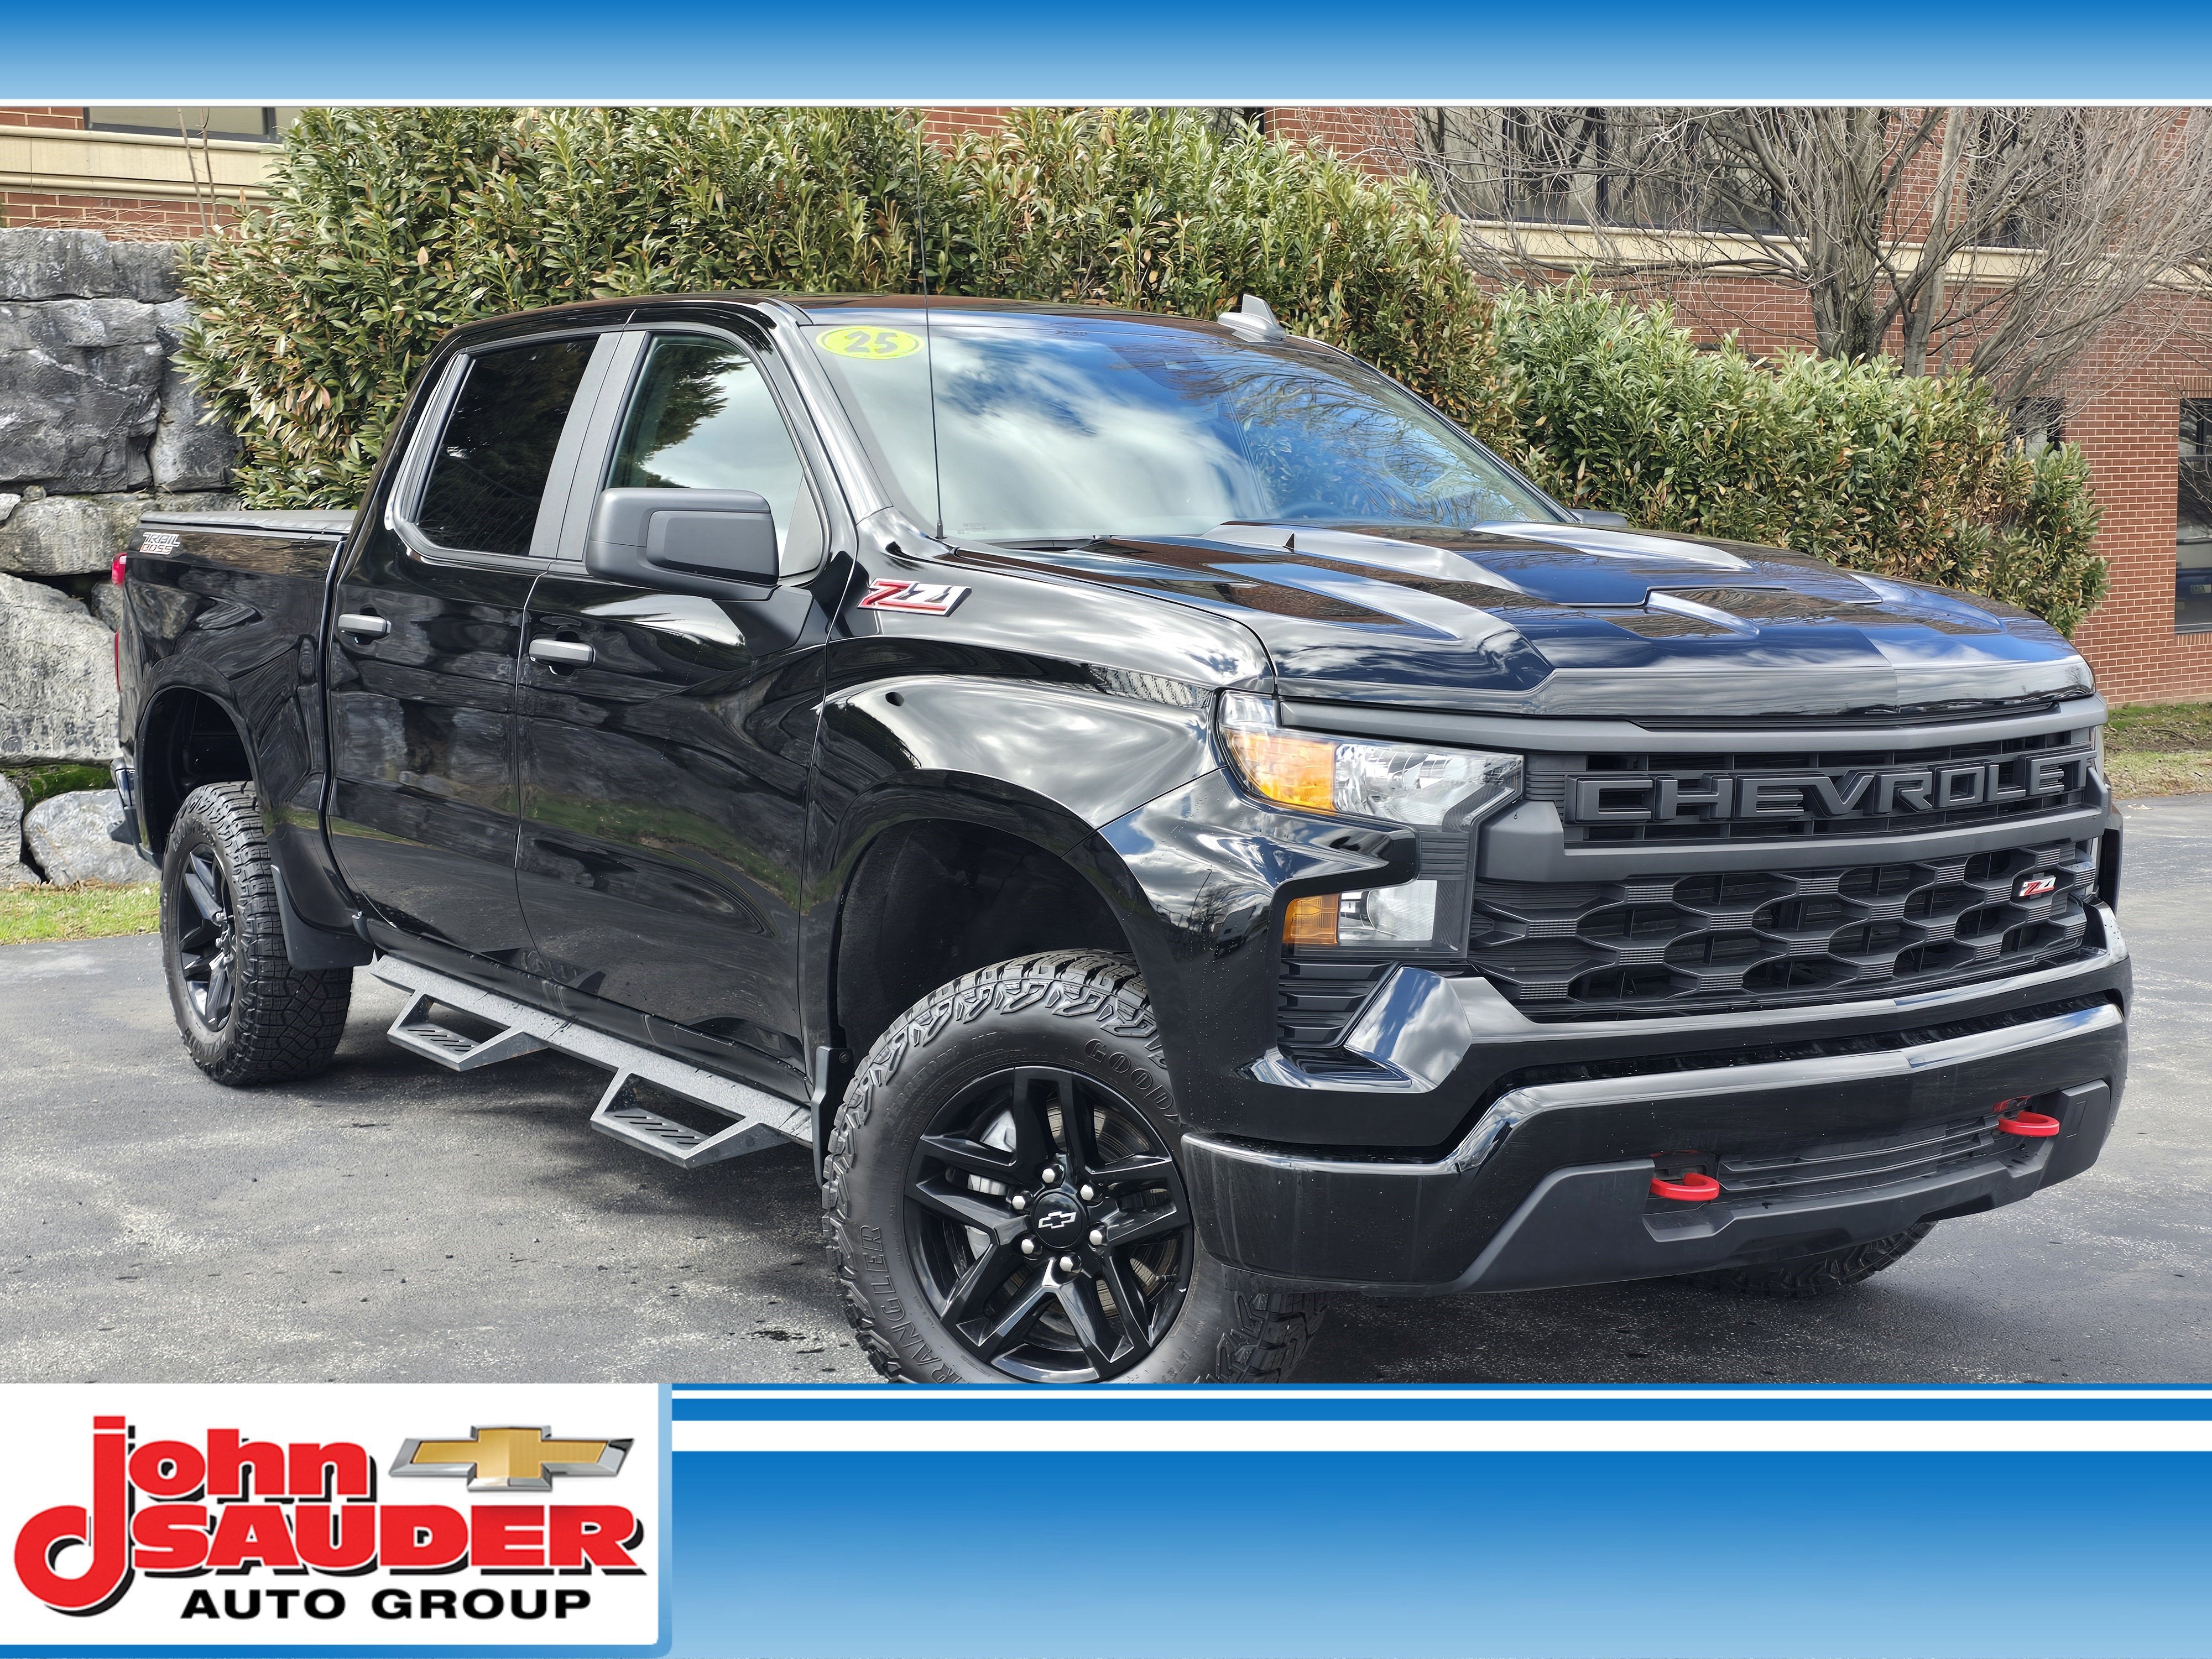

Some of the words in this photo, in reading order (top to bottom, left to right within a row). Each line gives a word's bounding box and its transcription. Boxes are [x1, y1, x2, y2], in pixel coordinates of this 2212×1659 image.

[844, 331, 898, 354] 25
[137, 544, 173, 555] BOSS
[142, 531, 181, 547] TRAIL
[857, 578, 972, 617] Z71
[1565, 748, 2098, 824] CHEVROLET
[2019, 876, 2056, 897] Z71
[860, 1225, 963, 1384] RANGLER
